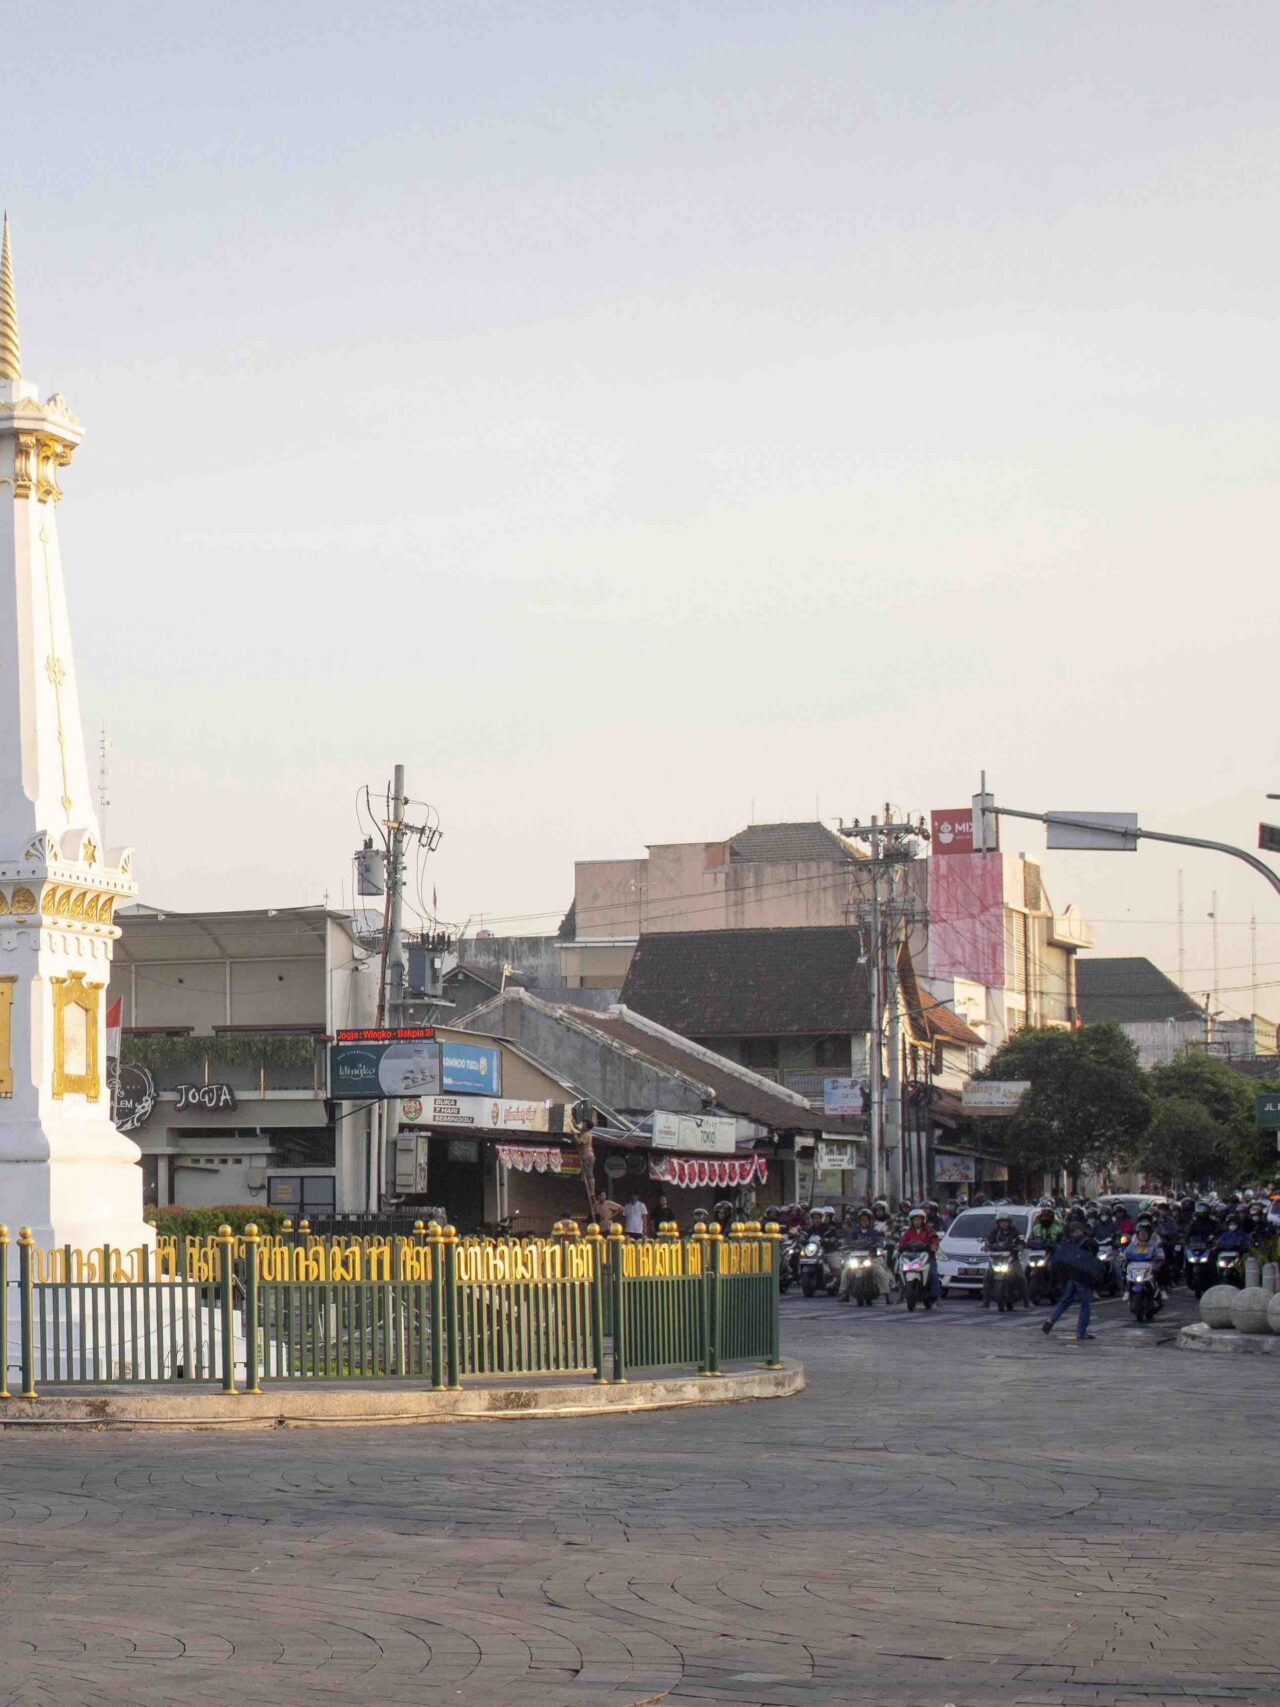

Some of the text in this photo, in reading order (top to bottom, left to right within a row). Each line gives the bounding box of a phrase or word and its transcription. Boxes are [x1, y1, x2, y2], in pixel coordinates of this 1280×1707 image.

[338, 1031, 358, 1040] Jogja
[363, 1030, 392, 1039] Wingko
[397, 1029, 424, 1039] Bakpia
[176, 1085, 232, 1107] JOGJA
